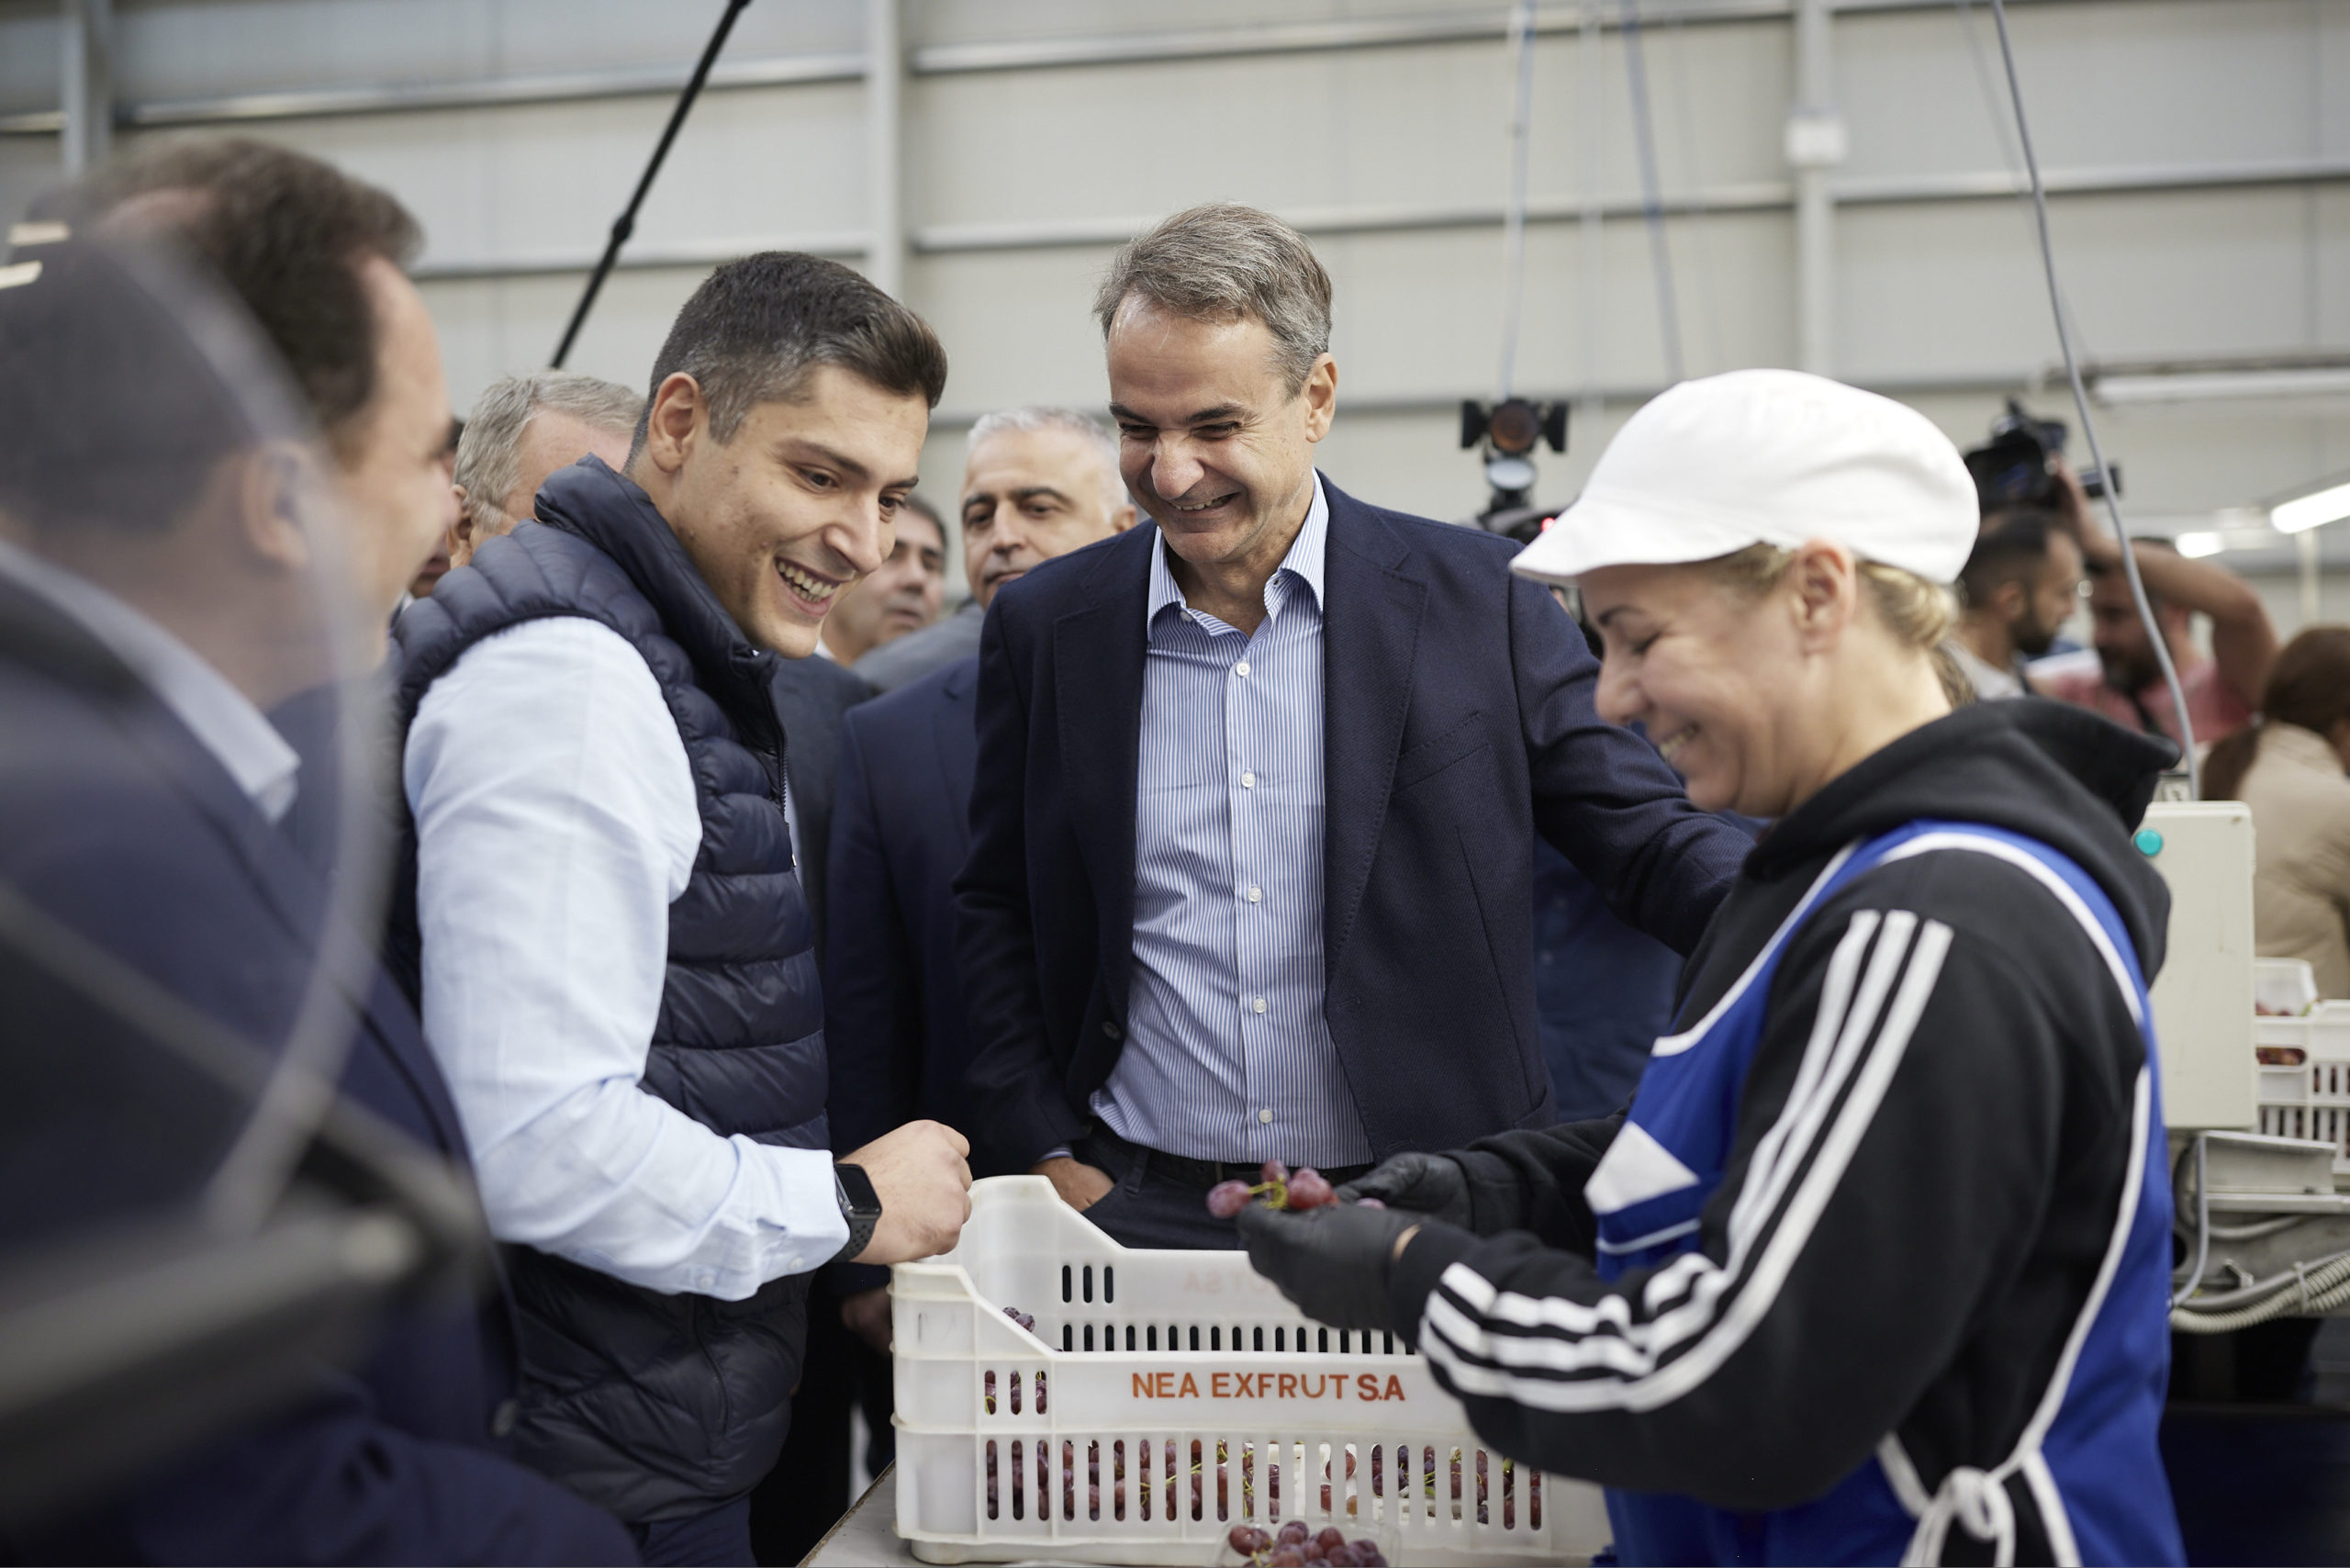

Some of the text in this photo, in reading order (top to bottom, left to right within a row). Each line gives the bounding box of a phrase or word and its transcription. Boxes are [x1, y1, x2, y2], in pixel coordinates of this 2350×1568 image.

[1131, 1372, 1406, 1402] NEA EXFRUT S.A
